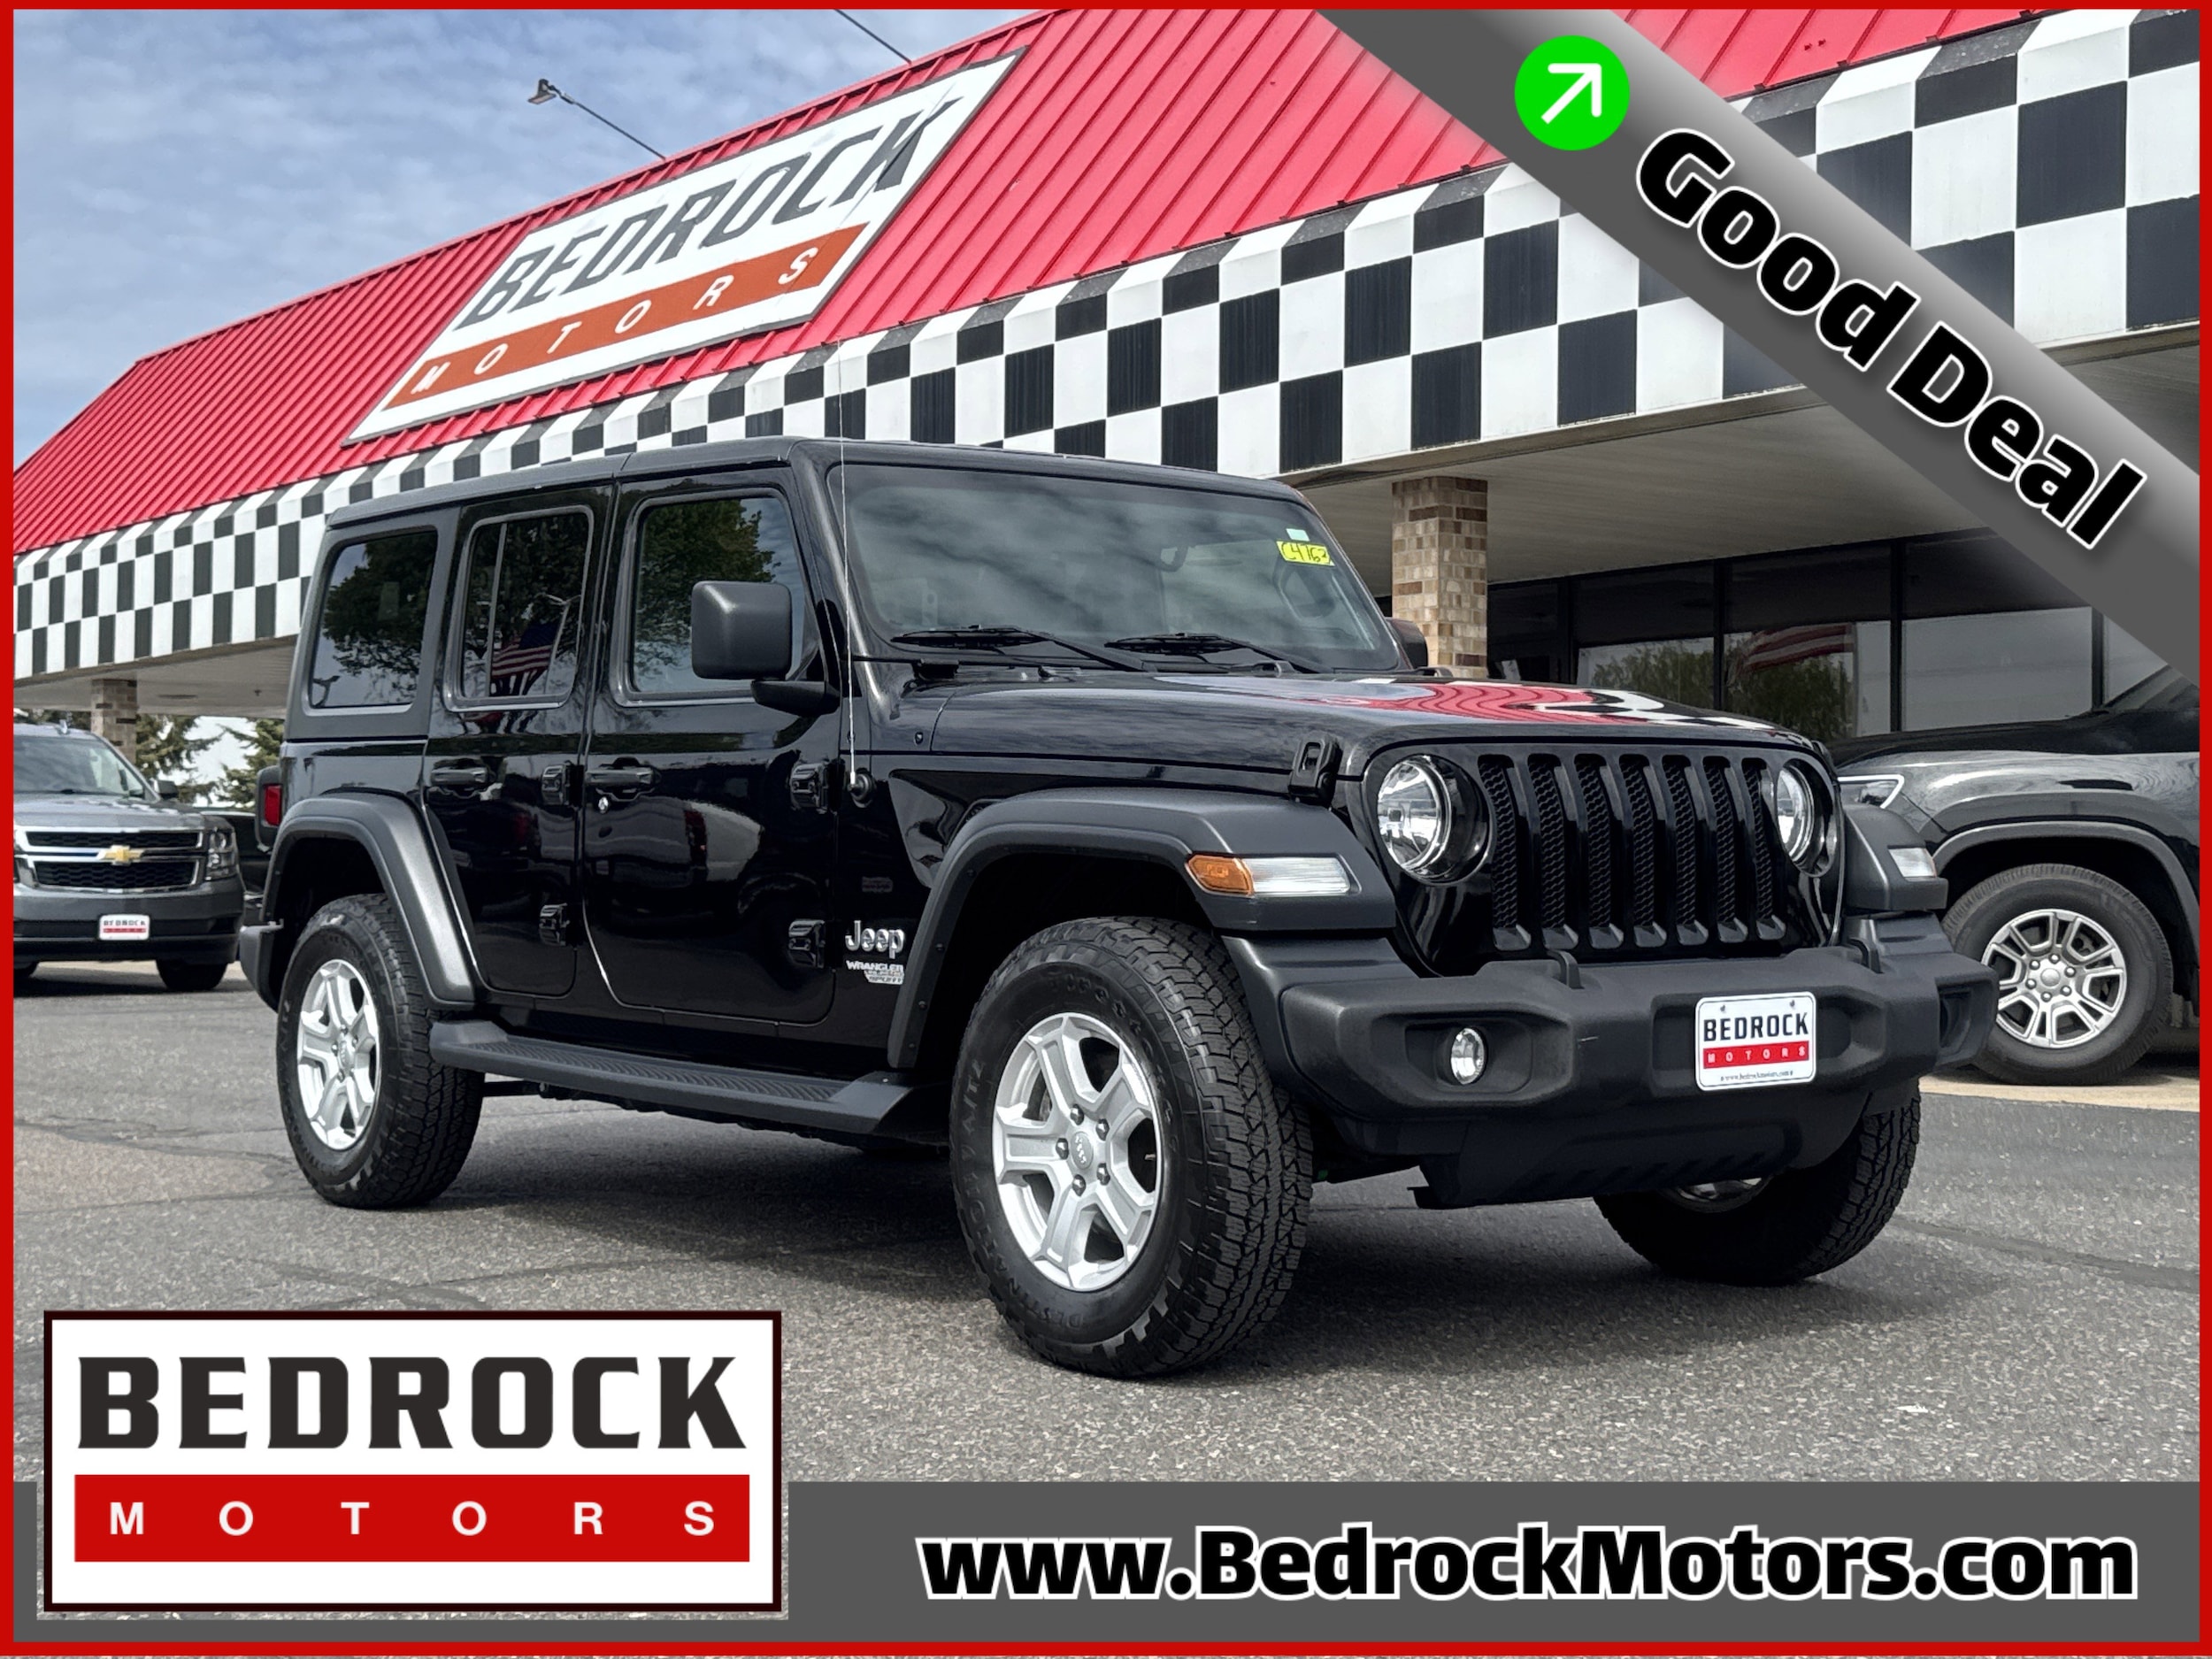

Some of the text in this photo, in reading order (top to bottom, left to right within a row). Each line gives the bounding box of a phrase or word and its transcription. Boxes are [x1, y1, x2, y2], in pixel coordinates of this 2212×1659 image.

[453, 96, 963, 331] BEDROCK
[410, 246, 818, 395] MOTORS
[844, 919, 905, 960] Jeep
[845, 960, 904, 972] WRANGLER
[1703, 1011, 1809, 1042] BEDROCK
[1707, 1045, 1806, 1064] MOTORS
